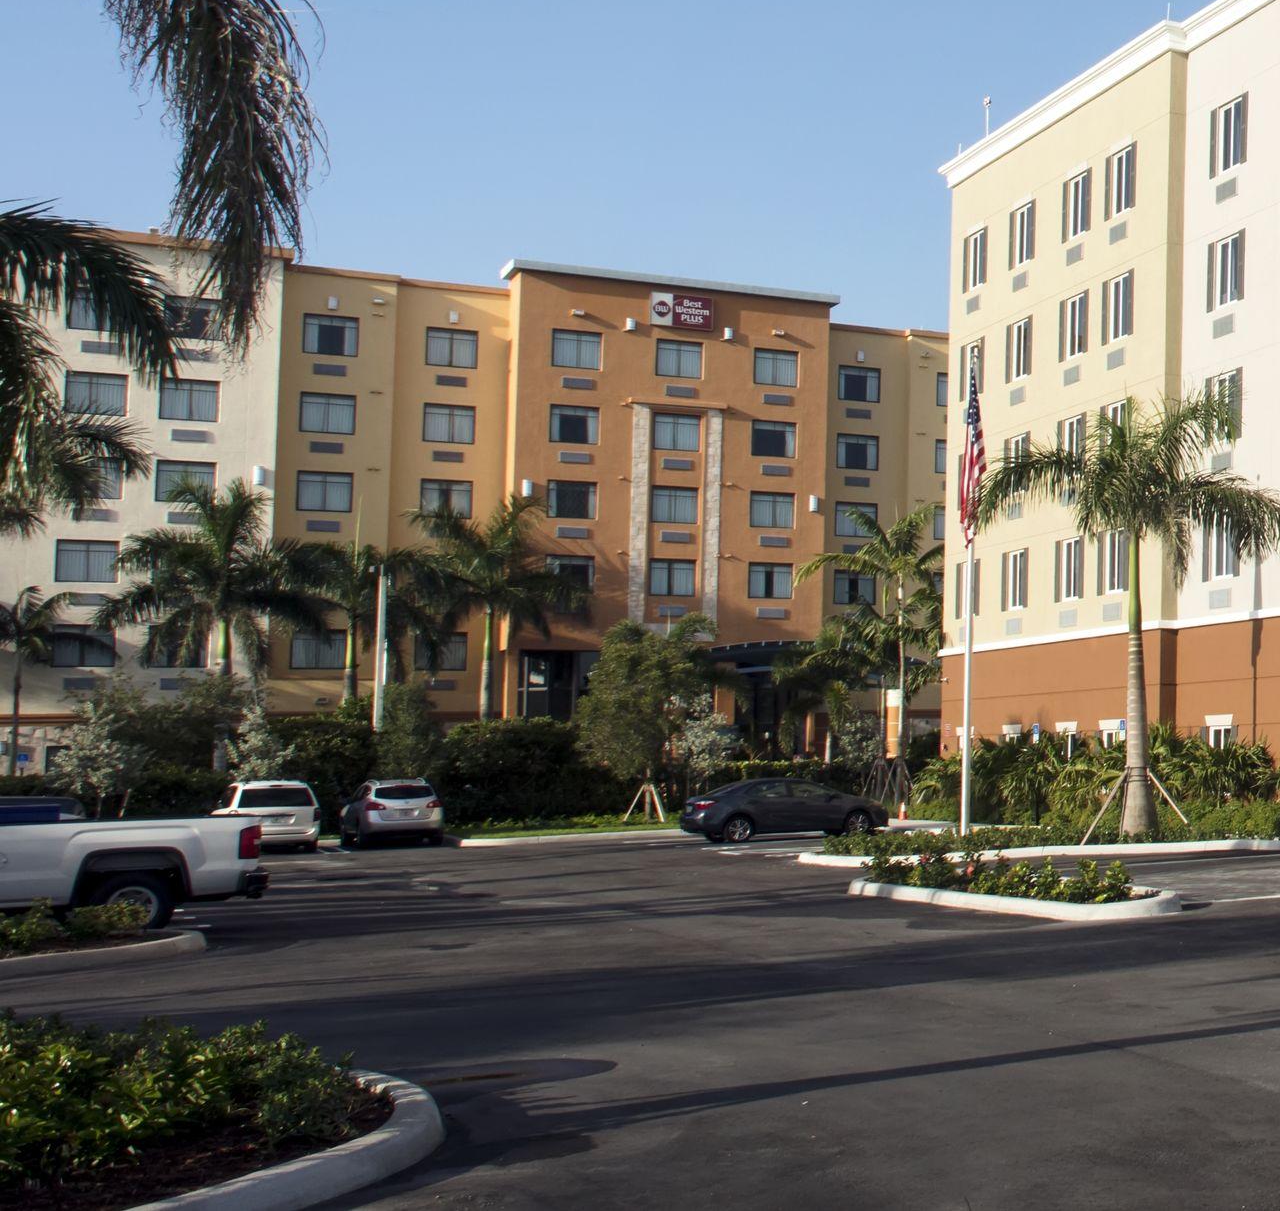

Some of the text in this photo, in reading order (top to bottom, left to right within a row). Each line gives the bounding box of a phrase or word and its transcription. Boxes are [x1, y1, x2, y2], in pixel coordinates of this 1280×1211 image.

[683, 299, 703, 308] Best
[655, 304, 669, 313] BW
[675, 305, 710, 316] Western
[681, 314, 704, 323] PLUS
